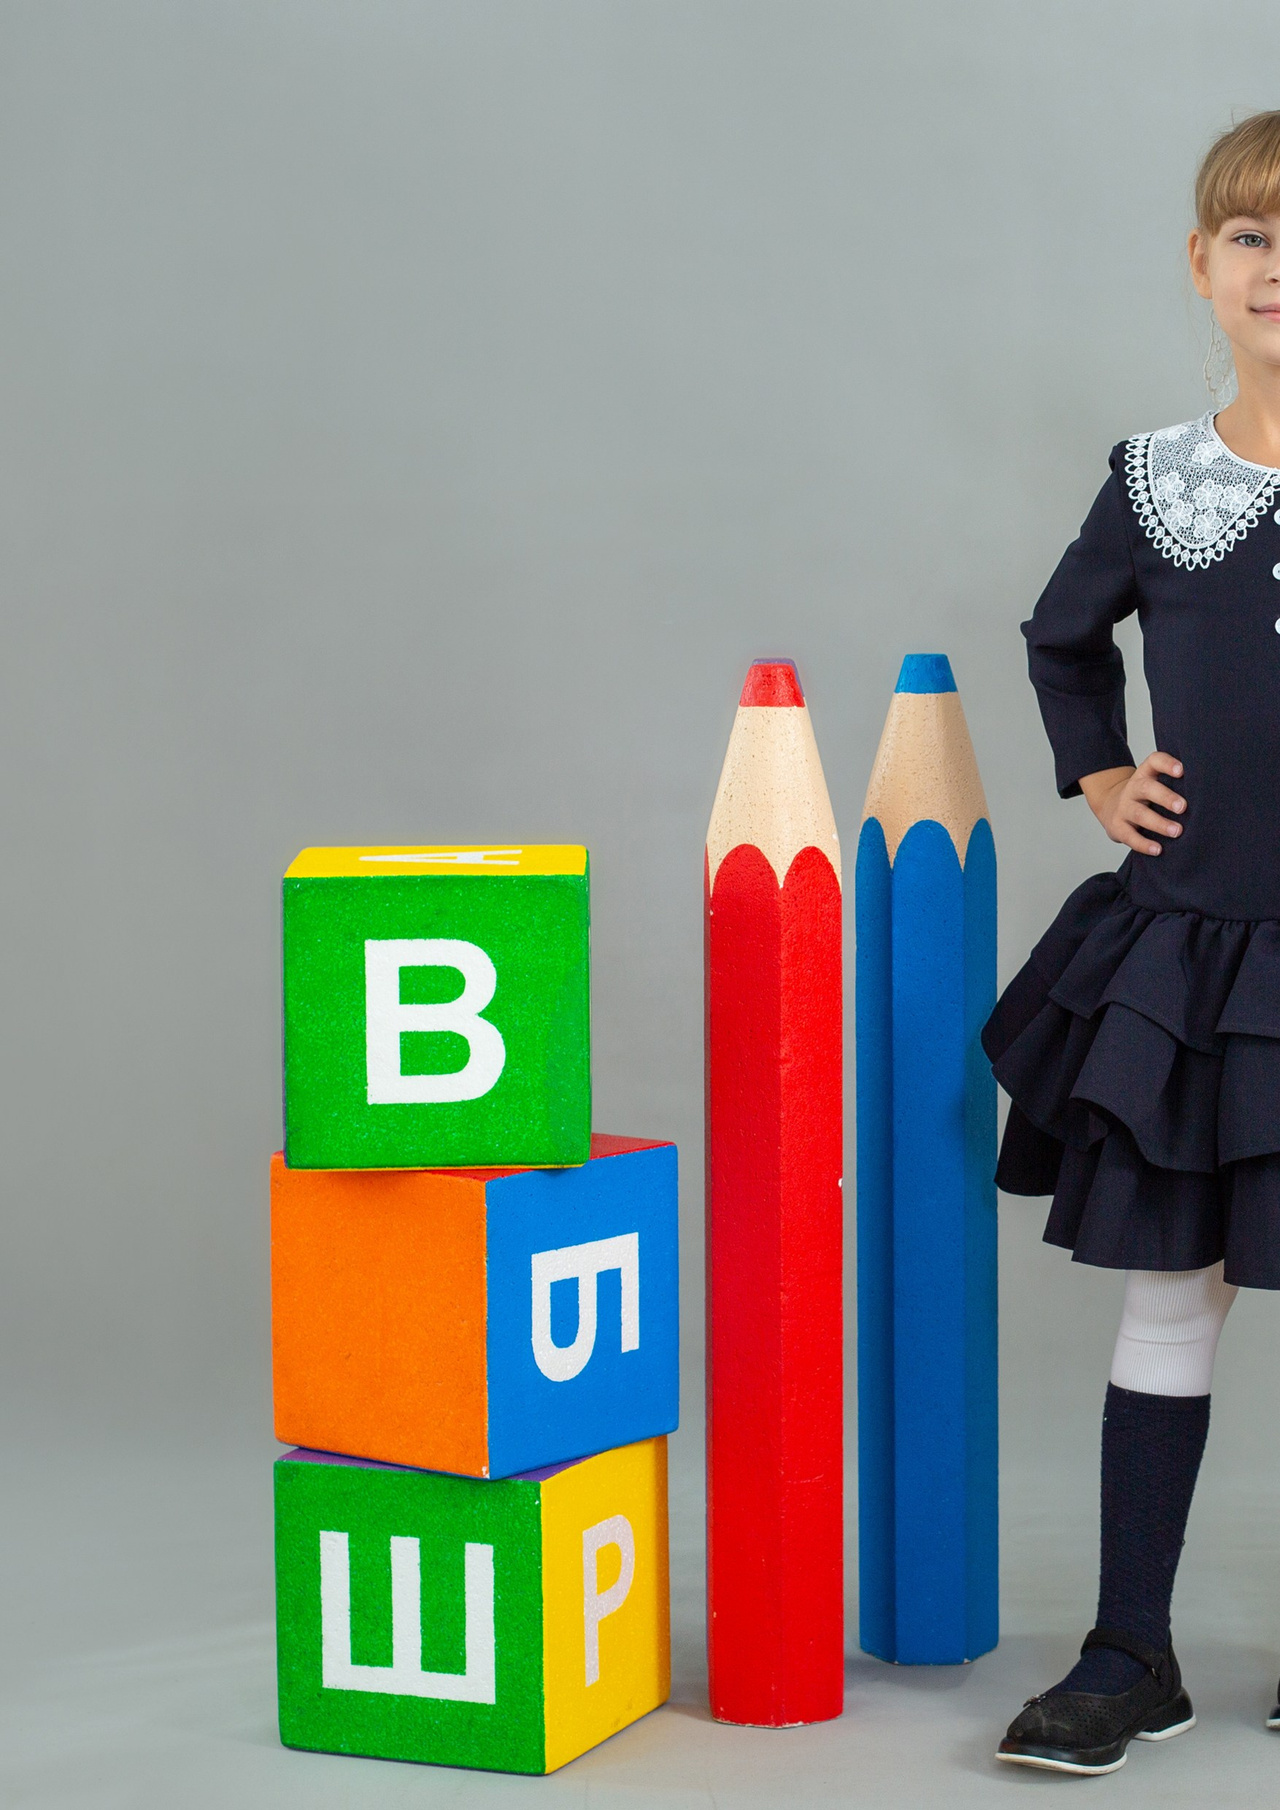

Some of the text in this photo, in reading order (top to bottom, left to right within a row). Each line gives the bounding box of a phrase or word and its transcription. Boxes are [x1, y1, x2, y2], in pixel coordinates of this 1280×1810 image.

[364, 938, 506, 1105] В
[531, 1231, 640, 1382] Б
[319, 1530, 496, 1705] Ш
[582, 1513, 635, 1687] Р
